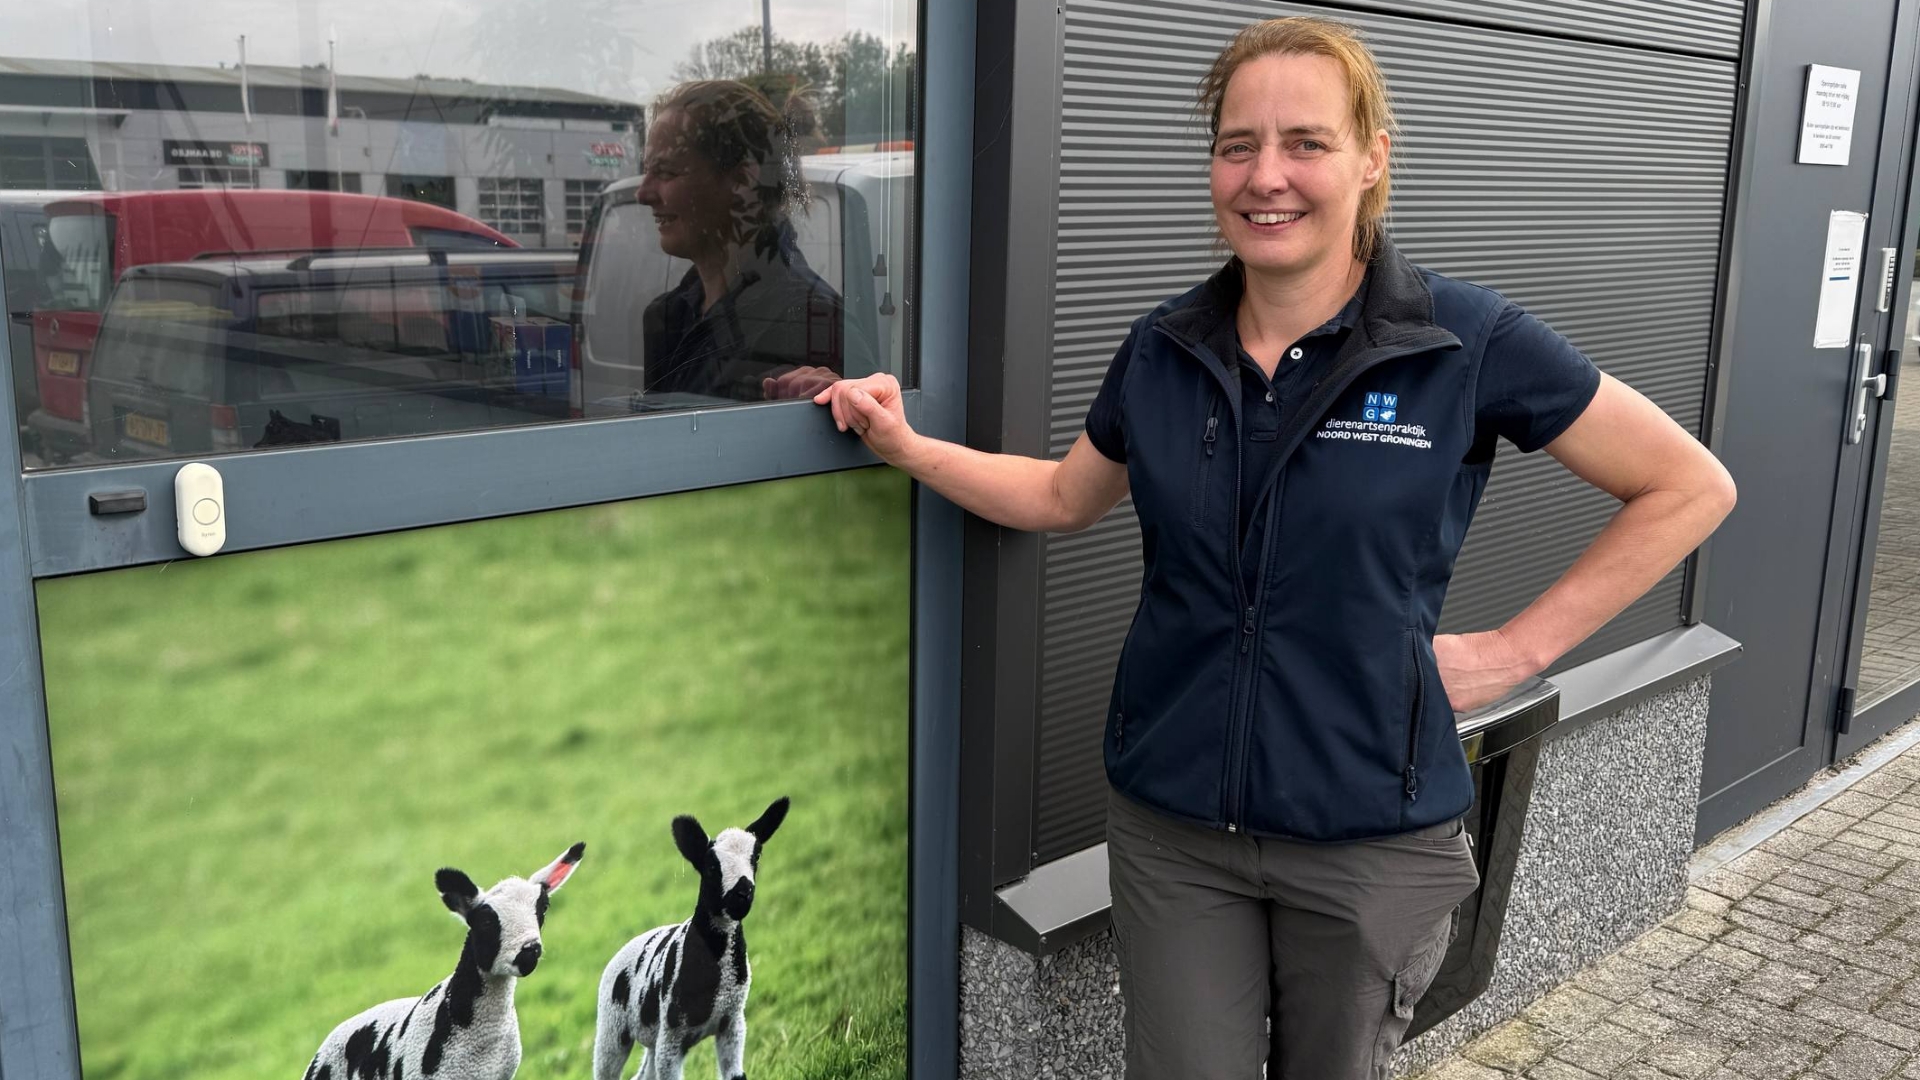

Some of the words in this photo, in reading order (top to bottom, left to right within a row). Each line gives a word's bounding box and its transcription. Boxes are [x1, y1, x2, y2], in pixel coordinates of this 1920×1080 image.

[1326, 418, 1426, 437] dierenartsenpraktijk
[1316, 430, 1351, 440] NOORD
[1352, 432, 1379, 442] WEST
[1380, 434, 1432, 449] GRONINGEN
